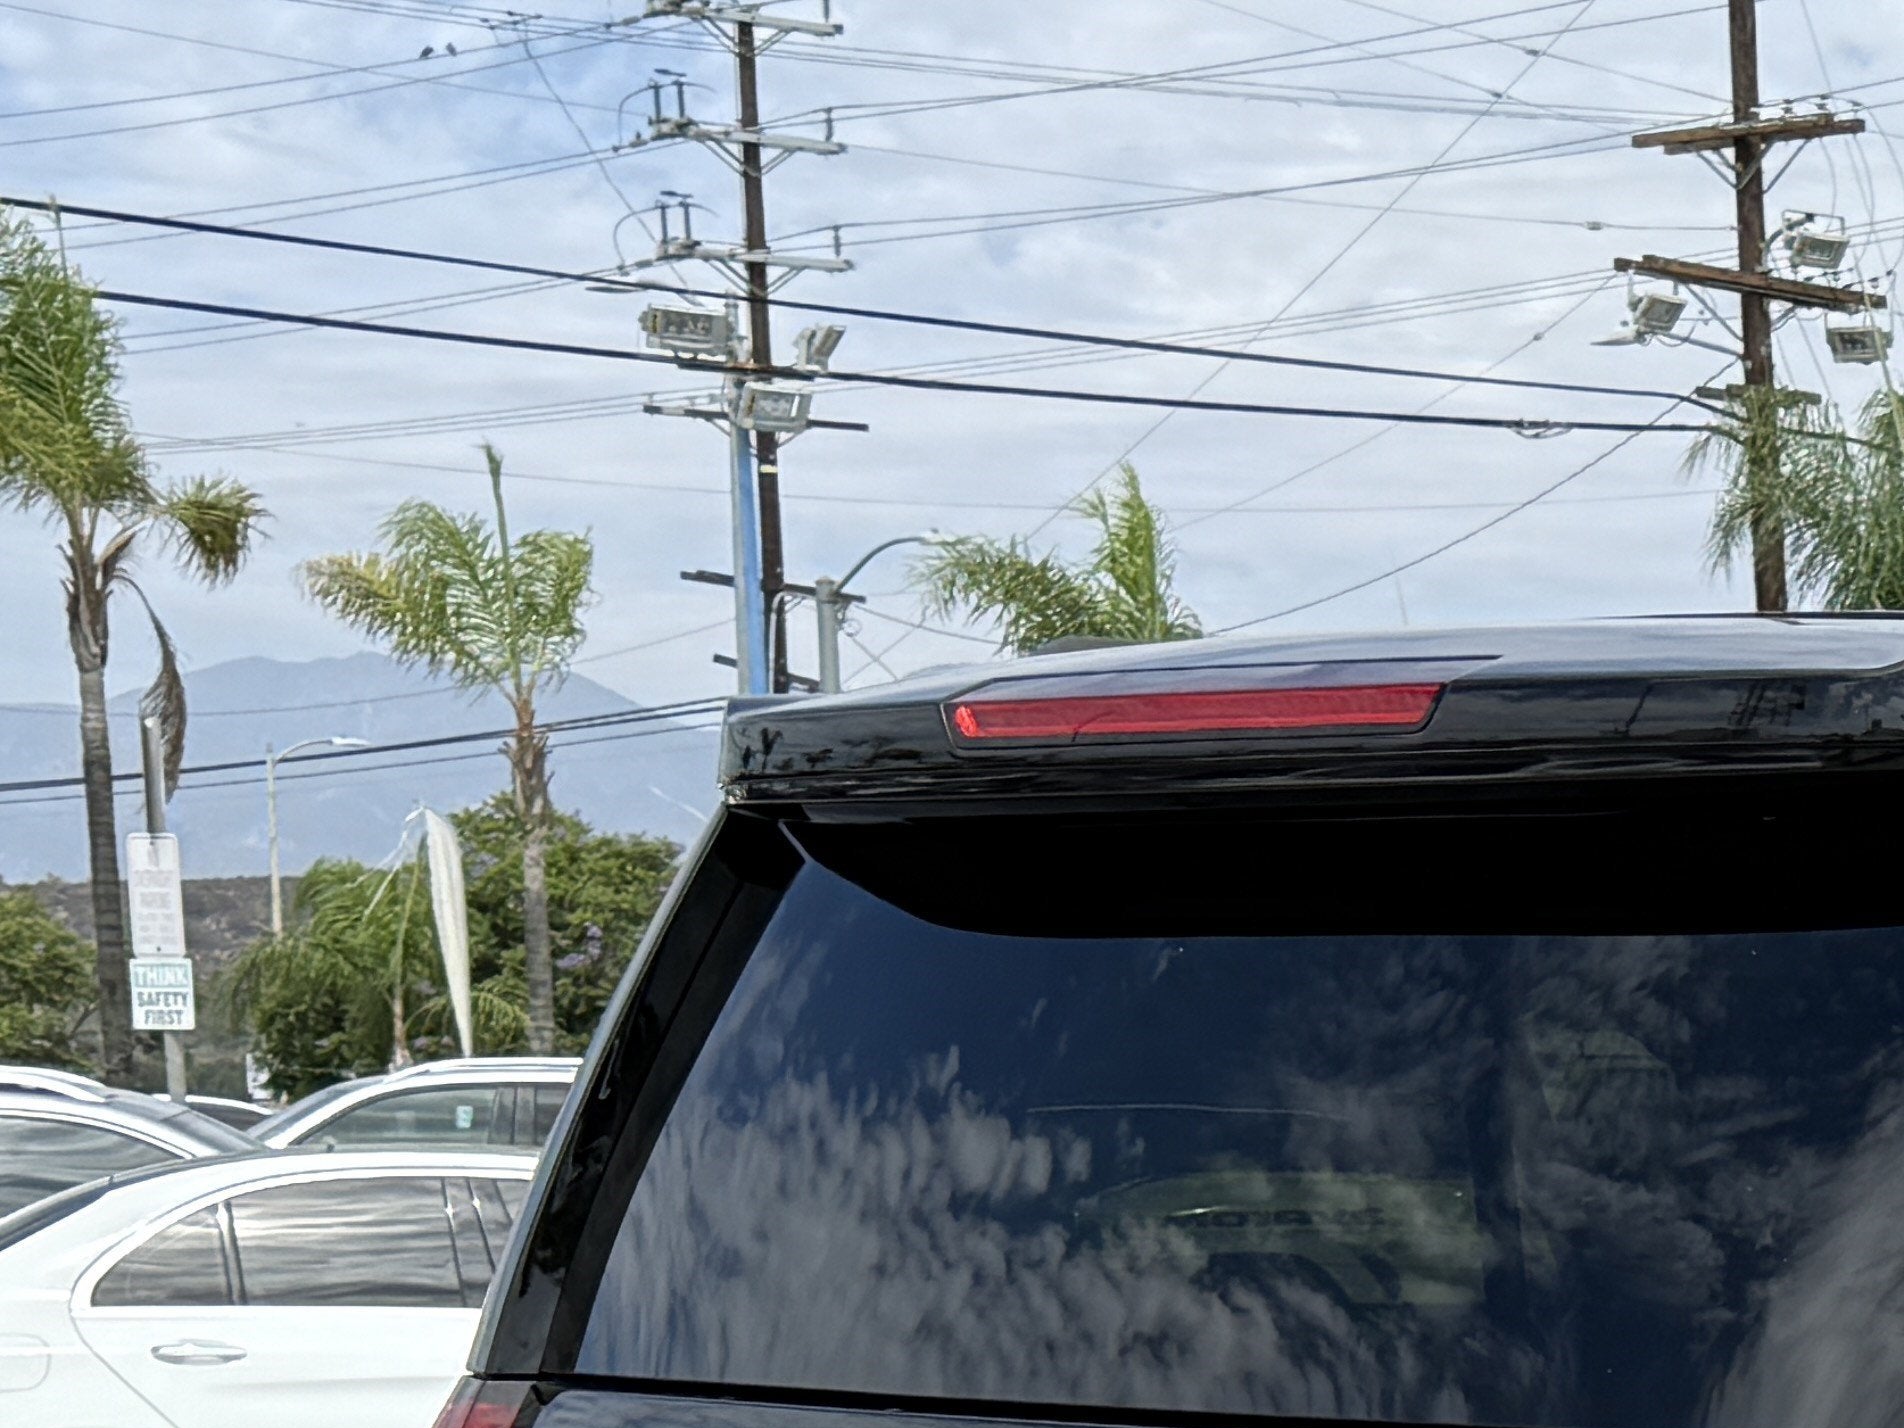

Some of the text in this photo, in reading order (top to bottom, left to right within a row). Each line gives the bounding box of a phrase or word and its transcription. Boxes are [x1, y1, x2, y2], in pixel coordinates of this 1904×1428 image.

[134, 965, 188, 987] THINK
[137, 991, 188, 1008] SAFETY
[144, 1009, 183, 1025] FIRST
